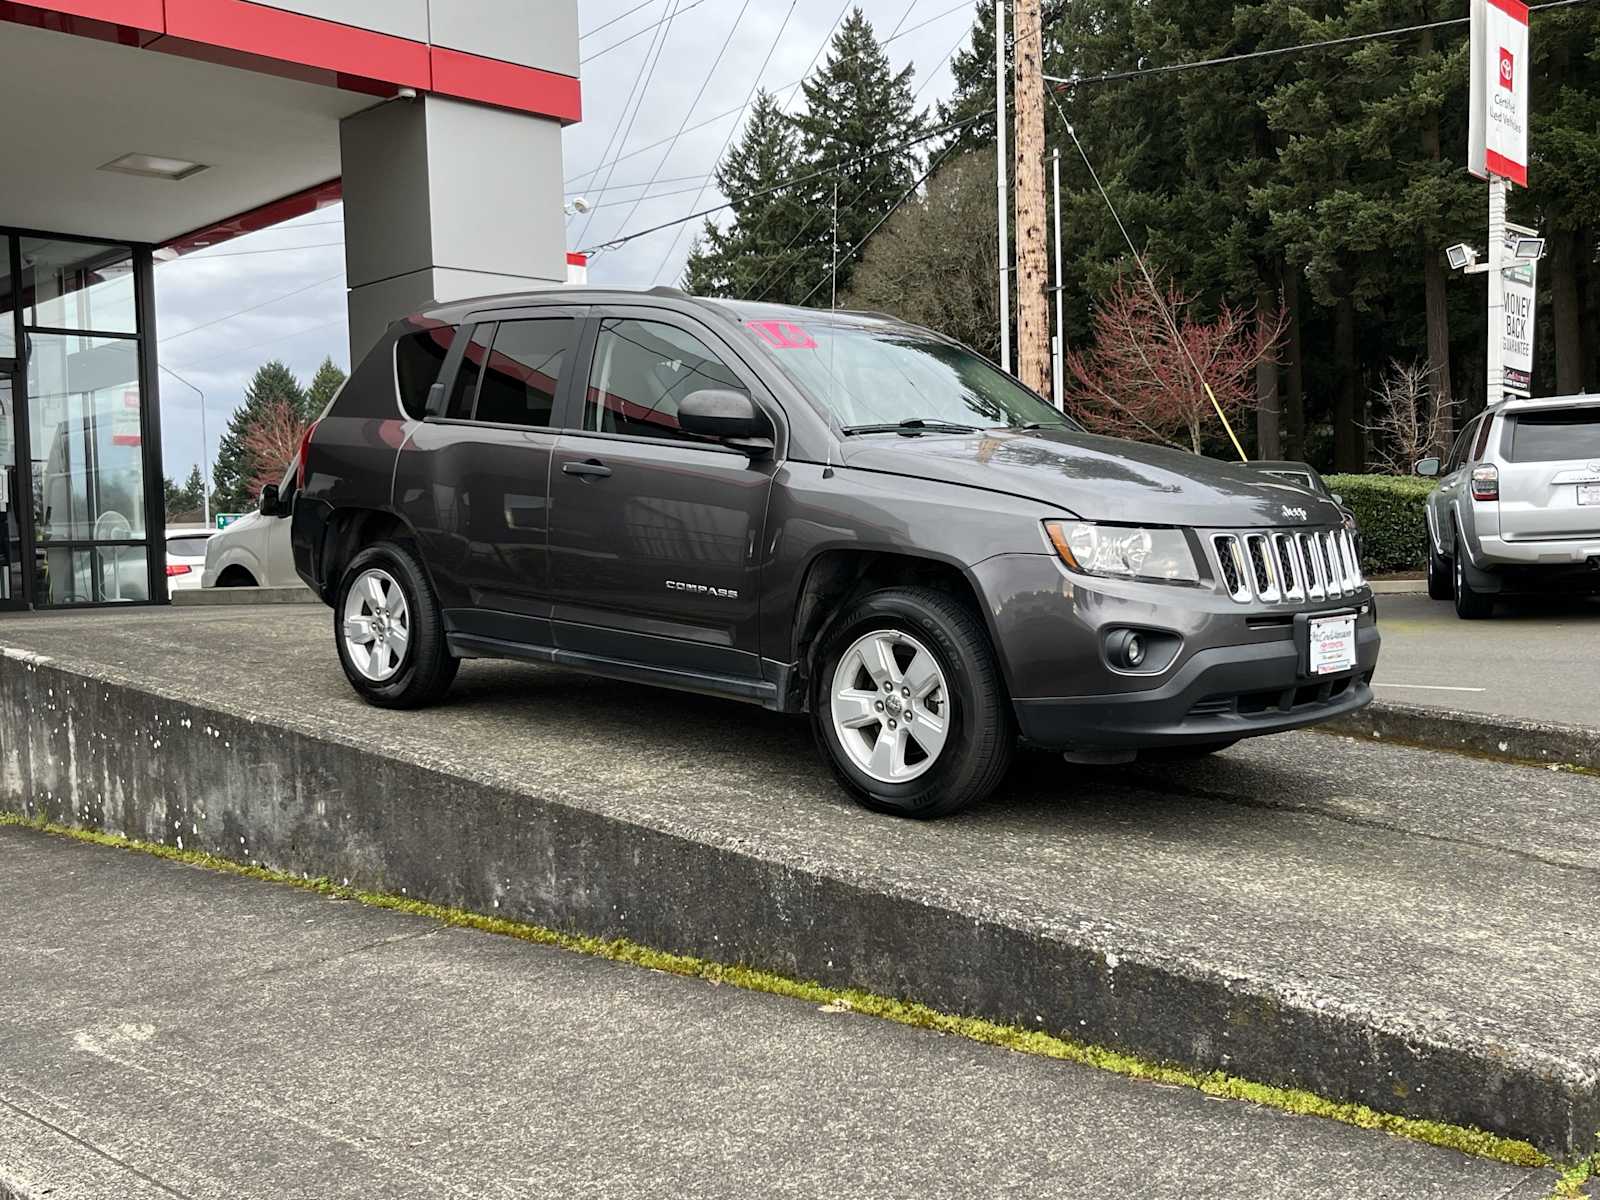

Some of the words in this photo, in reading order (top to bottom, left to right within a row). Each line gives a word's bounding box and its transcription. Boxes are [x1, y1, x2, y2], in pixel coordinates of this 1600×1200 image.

[1504, 291, 1531, 318] MONEY
[1507, 314, 1526, 340] BACK
[1281, 504, 1307, 521] Jeep
[665, 580, 738, 599] COMPASS
